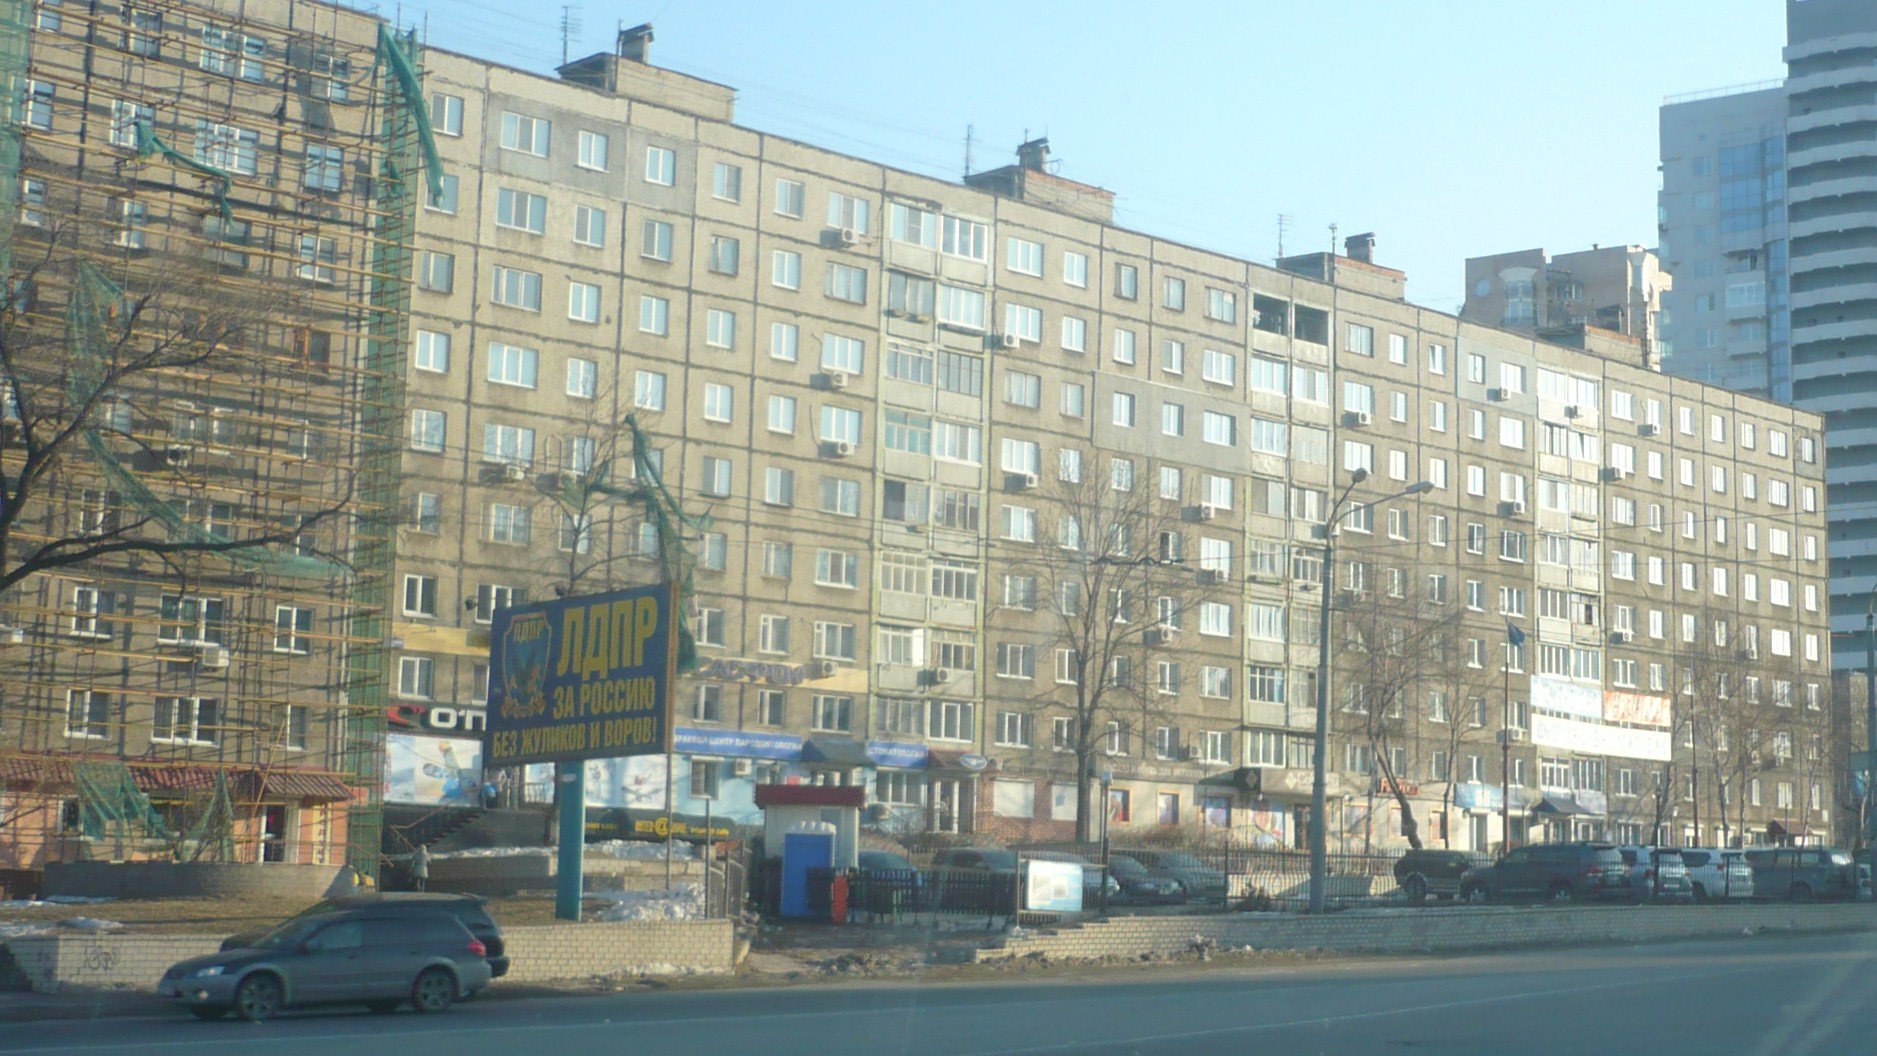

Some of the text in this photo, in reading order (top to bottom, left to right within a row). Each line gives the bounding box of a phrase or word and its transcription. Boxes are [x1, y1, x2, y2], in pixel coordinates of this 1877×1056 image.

[512, 619, 546, 645] ЛДПР
[557, 596, 658, 682] ЛДПР
[552, 676, 656, 720] ЗА РОССИЮ
[492, 716, 658, 759] БЕЗ ЖУЛИКОВ И ВОРОВ!
